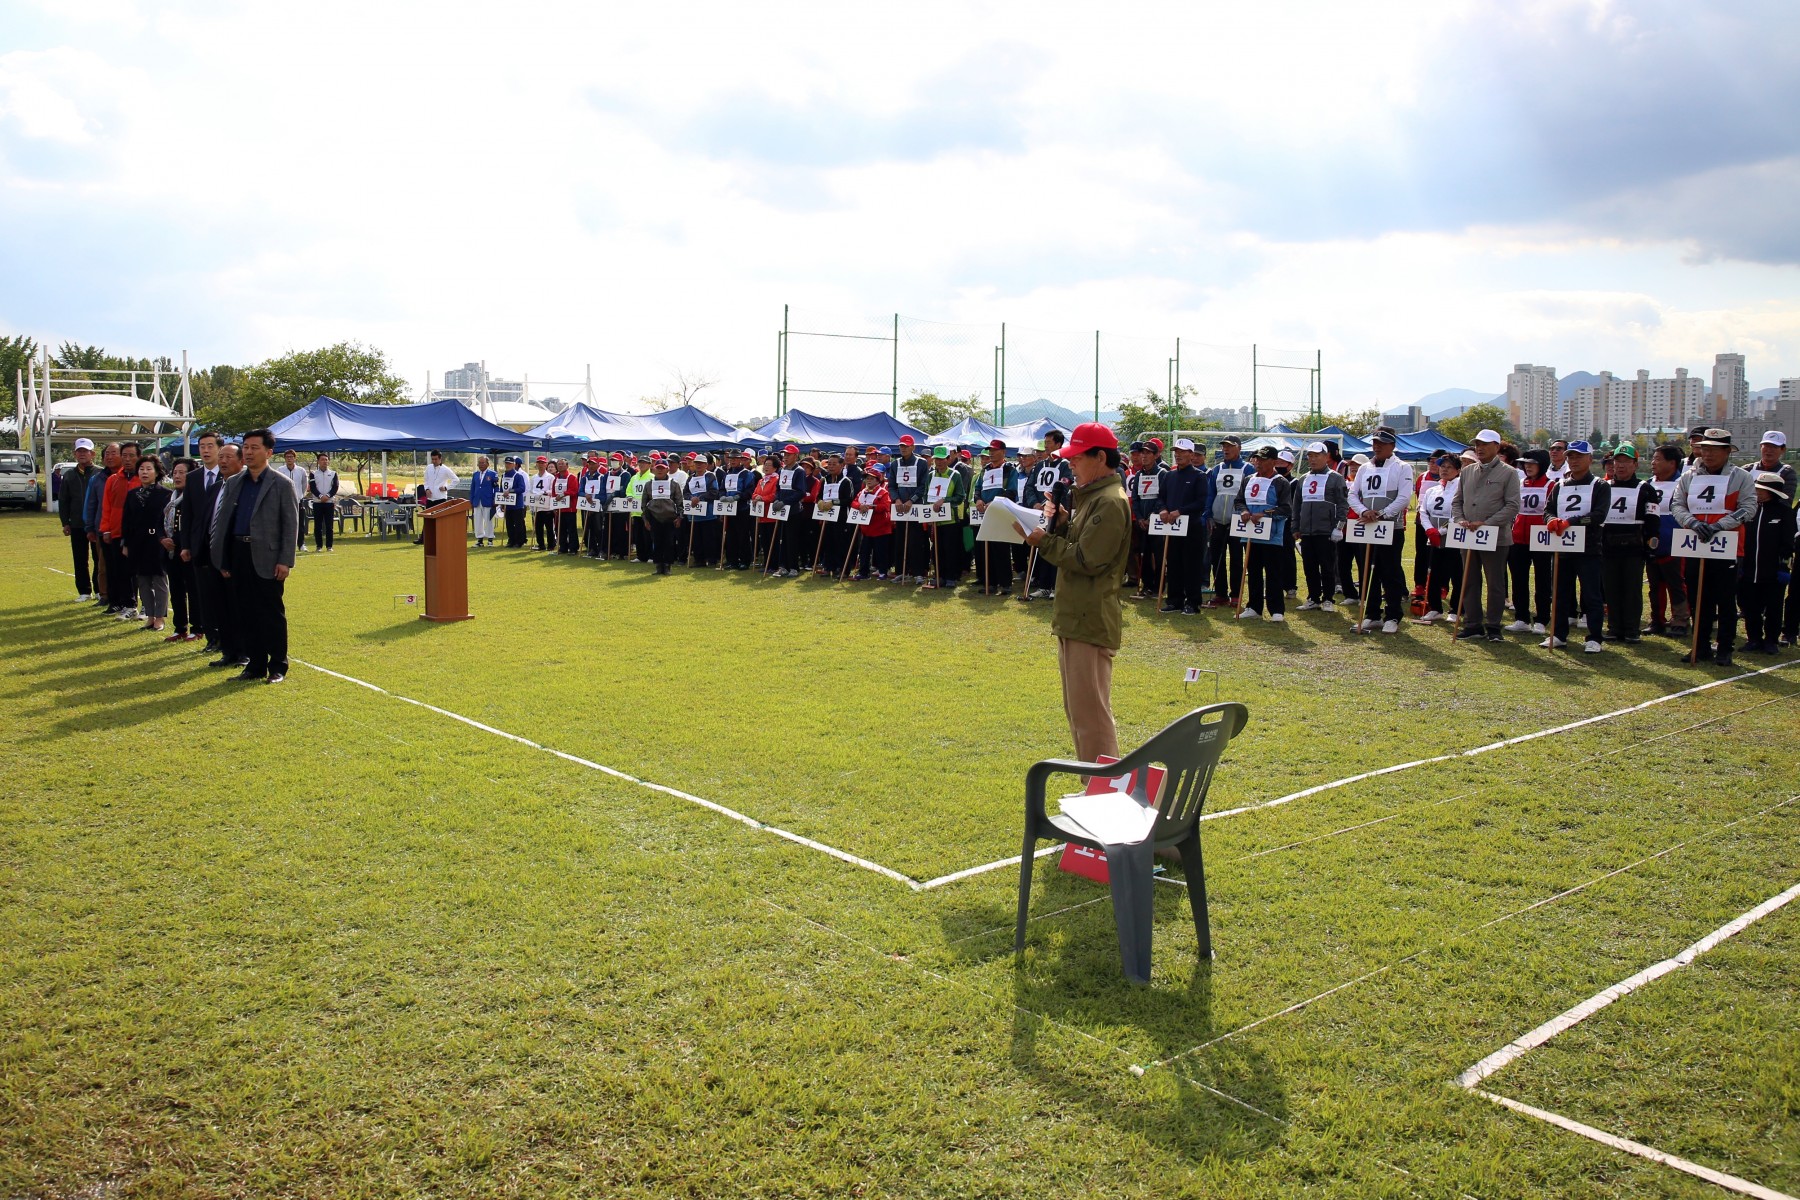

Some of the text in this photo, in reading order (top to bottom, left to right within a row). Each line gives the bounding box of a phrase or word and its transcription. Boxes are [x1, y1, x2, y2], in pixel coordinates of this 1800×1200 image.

[782, 475, 787, 484] 3
[903, 472, 910, 481] 5
[989, 474, 994, 484] 1
[1040, 471, 1055, 486] 10
[1223, 474, 1234, 488] 8
[1366, 474, 1382, 490] 10
[504, 482, 509, 490] 8
[536, 480, 544, 490] 4
[609, 479, 615, 490] 1
[658, 486, 664, 494] 5
[935, 485, 941, 496] 1
[1142, 481, 1152, 493] 7
[1250, 483, 1260, 497] 9
[1309, 480, 1318, 494] 3
[1522, 494, 1539, 508] 10
[1697, 485, 1715, 503] 4
[1434, 496, 1445, 511] 2
[1565, 494, 1582, 512] 2
[1611, 496, 1627, 513] 4
[923, 506, 946, 519] 당진
[1236, 519, 1265, 534] 보령
[1353, 523, 1387, 539] 금산
[1453, 527, 1490, 545] 태안
[1537, 530, 1577, 546] 예산
[1680, 534, 1728, 553] 서산
[407, 595, 414, 603] 3
